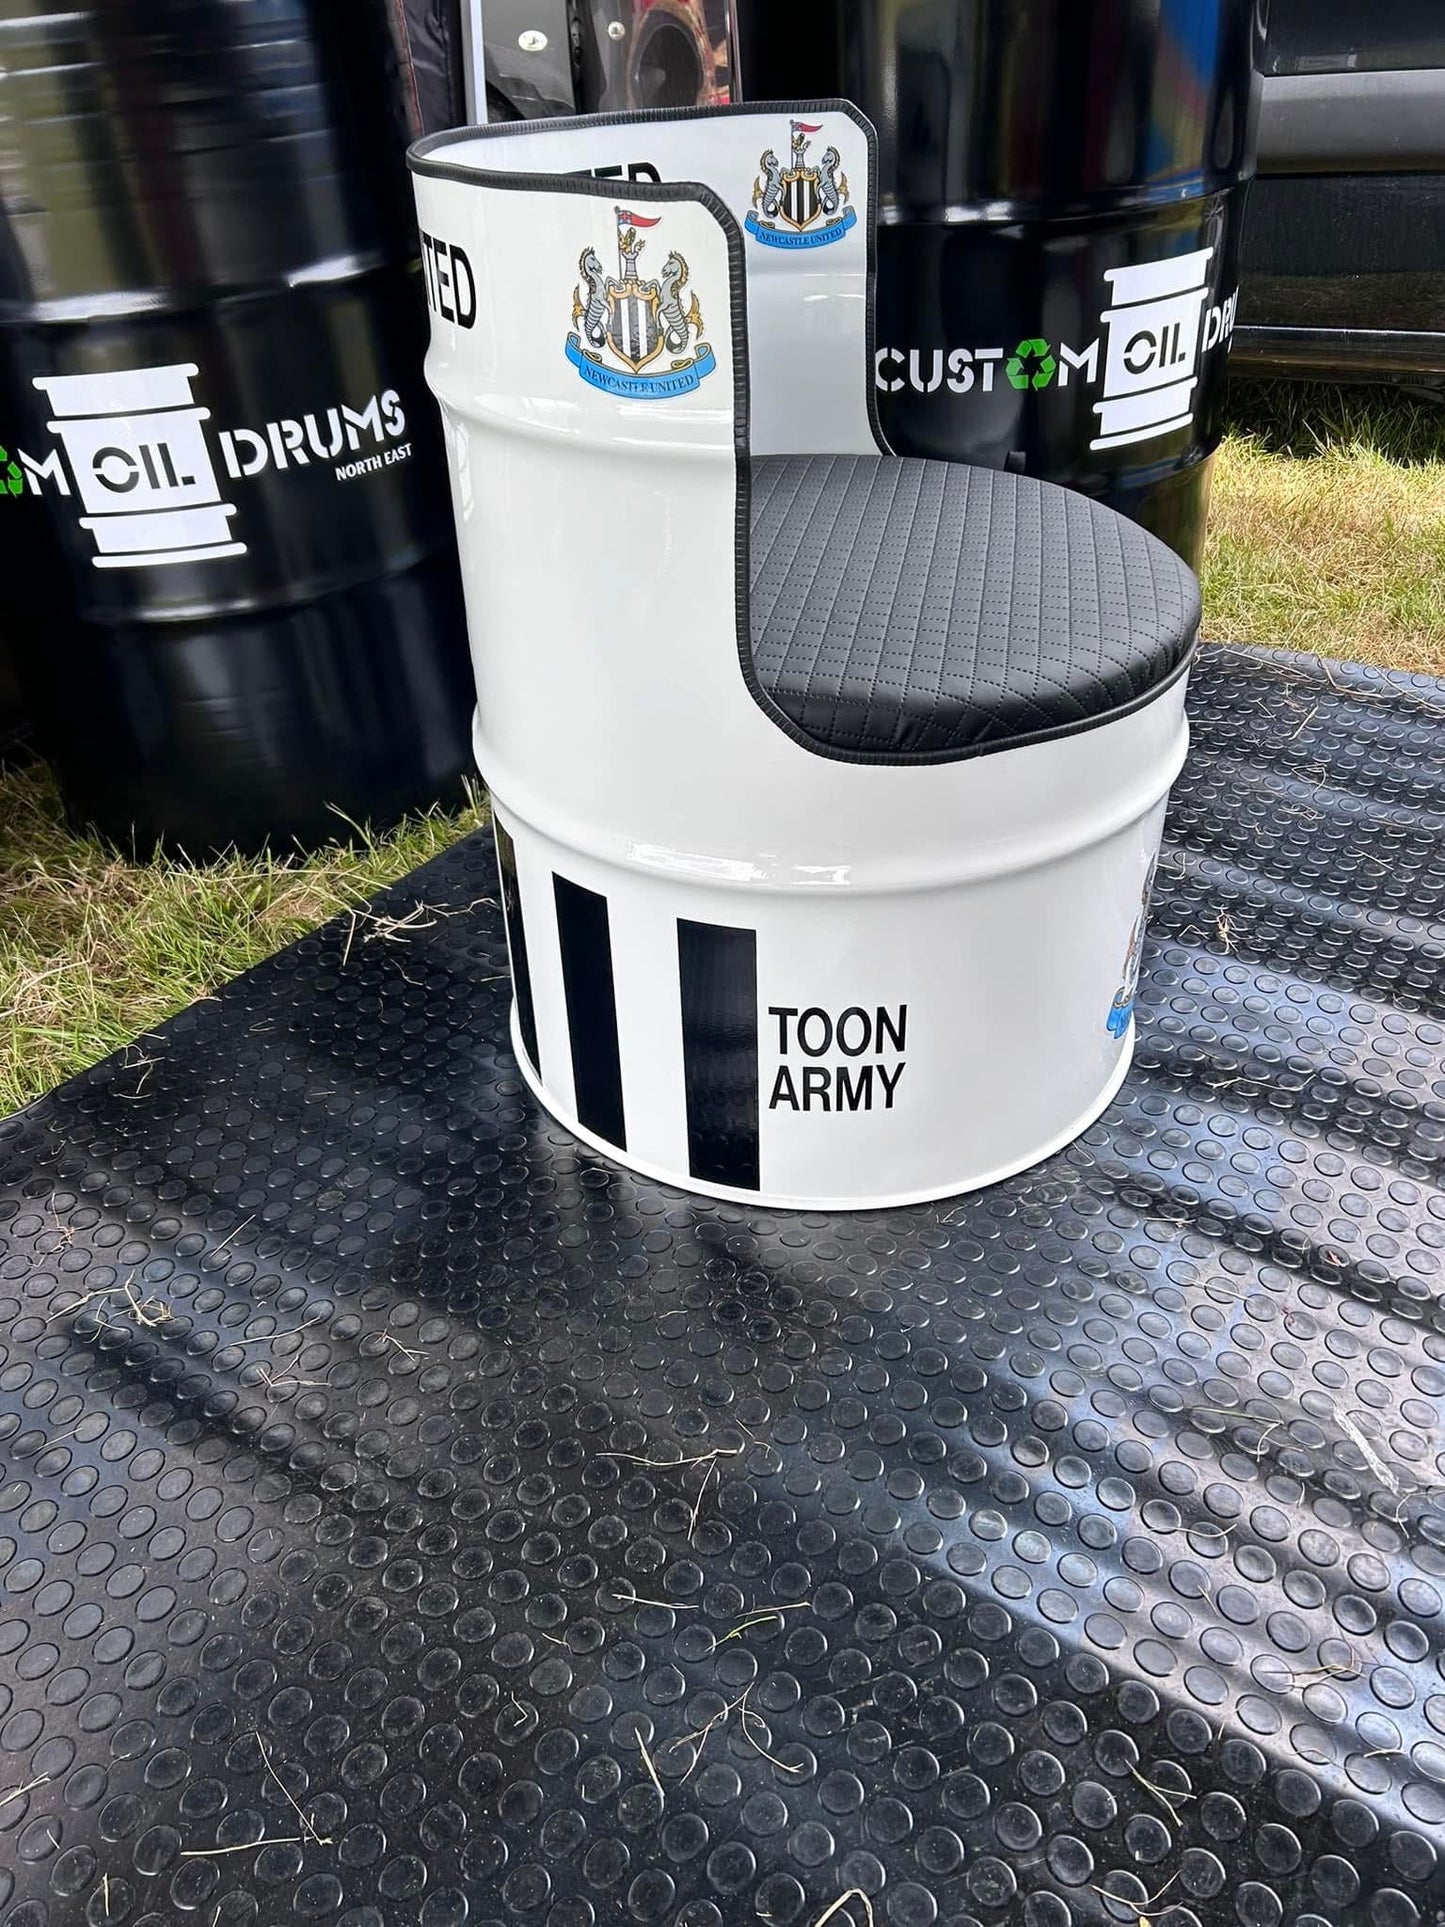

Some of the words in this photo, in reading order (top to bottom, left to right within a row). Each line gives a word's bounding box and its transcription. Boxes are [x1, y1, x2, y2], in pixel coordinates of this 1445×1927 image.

[760, 231, 810, 246] NEWCASTLE
[810, 229, 842, 244] UNITED
[1124, 322, 1186, 375] OIL
[584, 365, 648, 393] NEWCASTLE
[648, 374, 694, 392] UNITED
[92, 442, 197, 493] OIL
[218, 389, 406, 479] DRUMS
[335, 455, 383, 482] NORTH
[384, 443, 413, 470] EAST
[768, 1004, 907, 1057] TOON
[768, 1062, 906, 1112] ARMY
